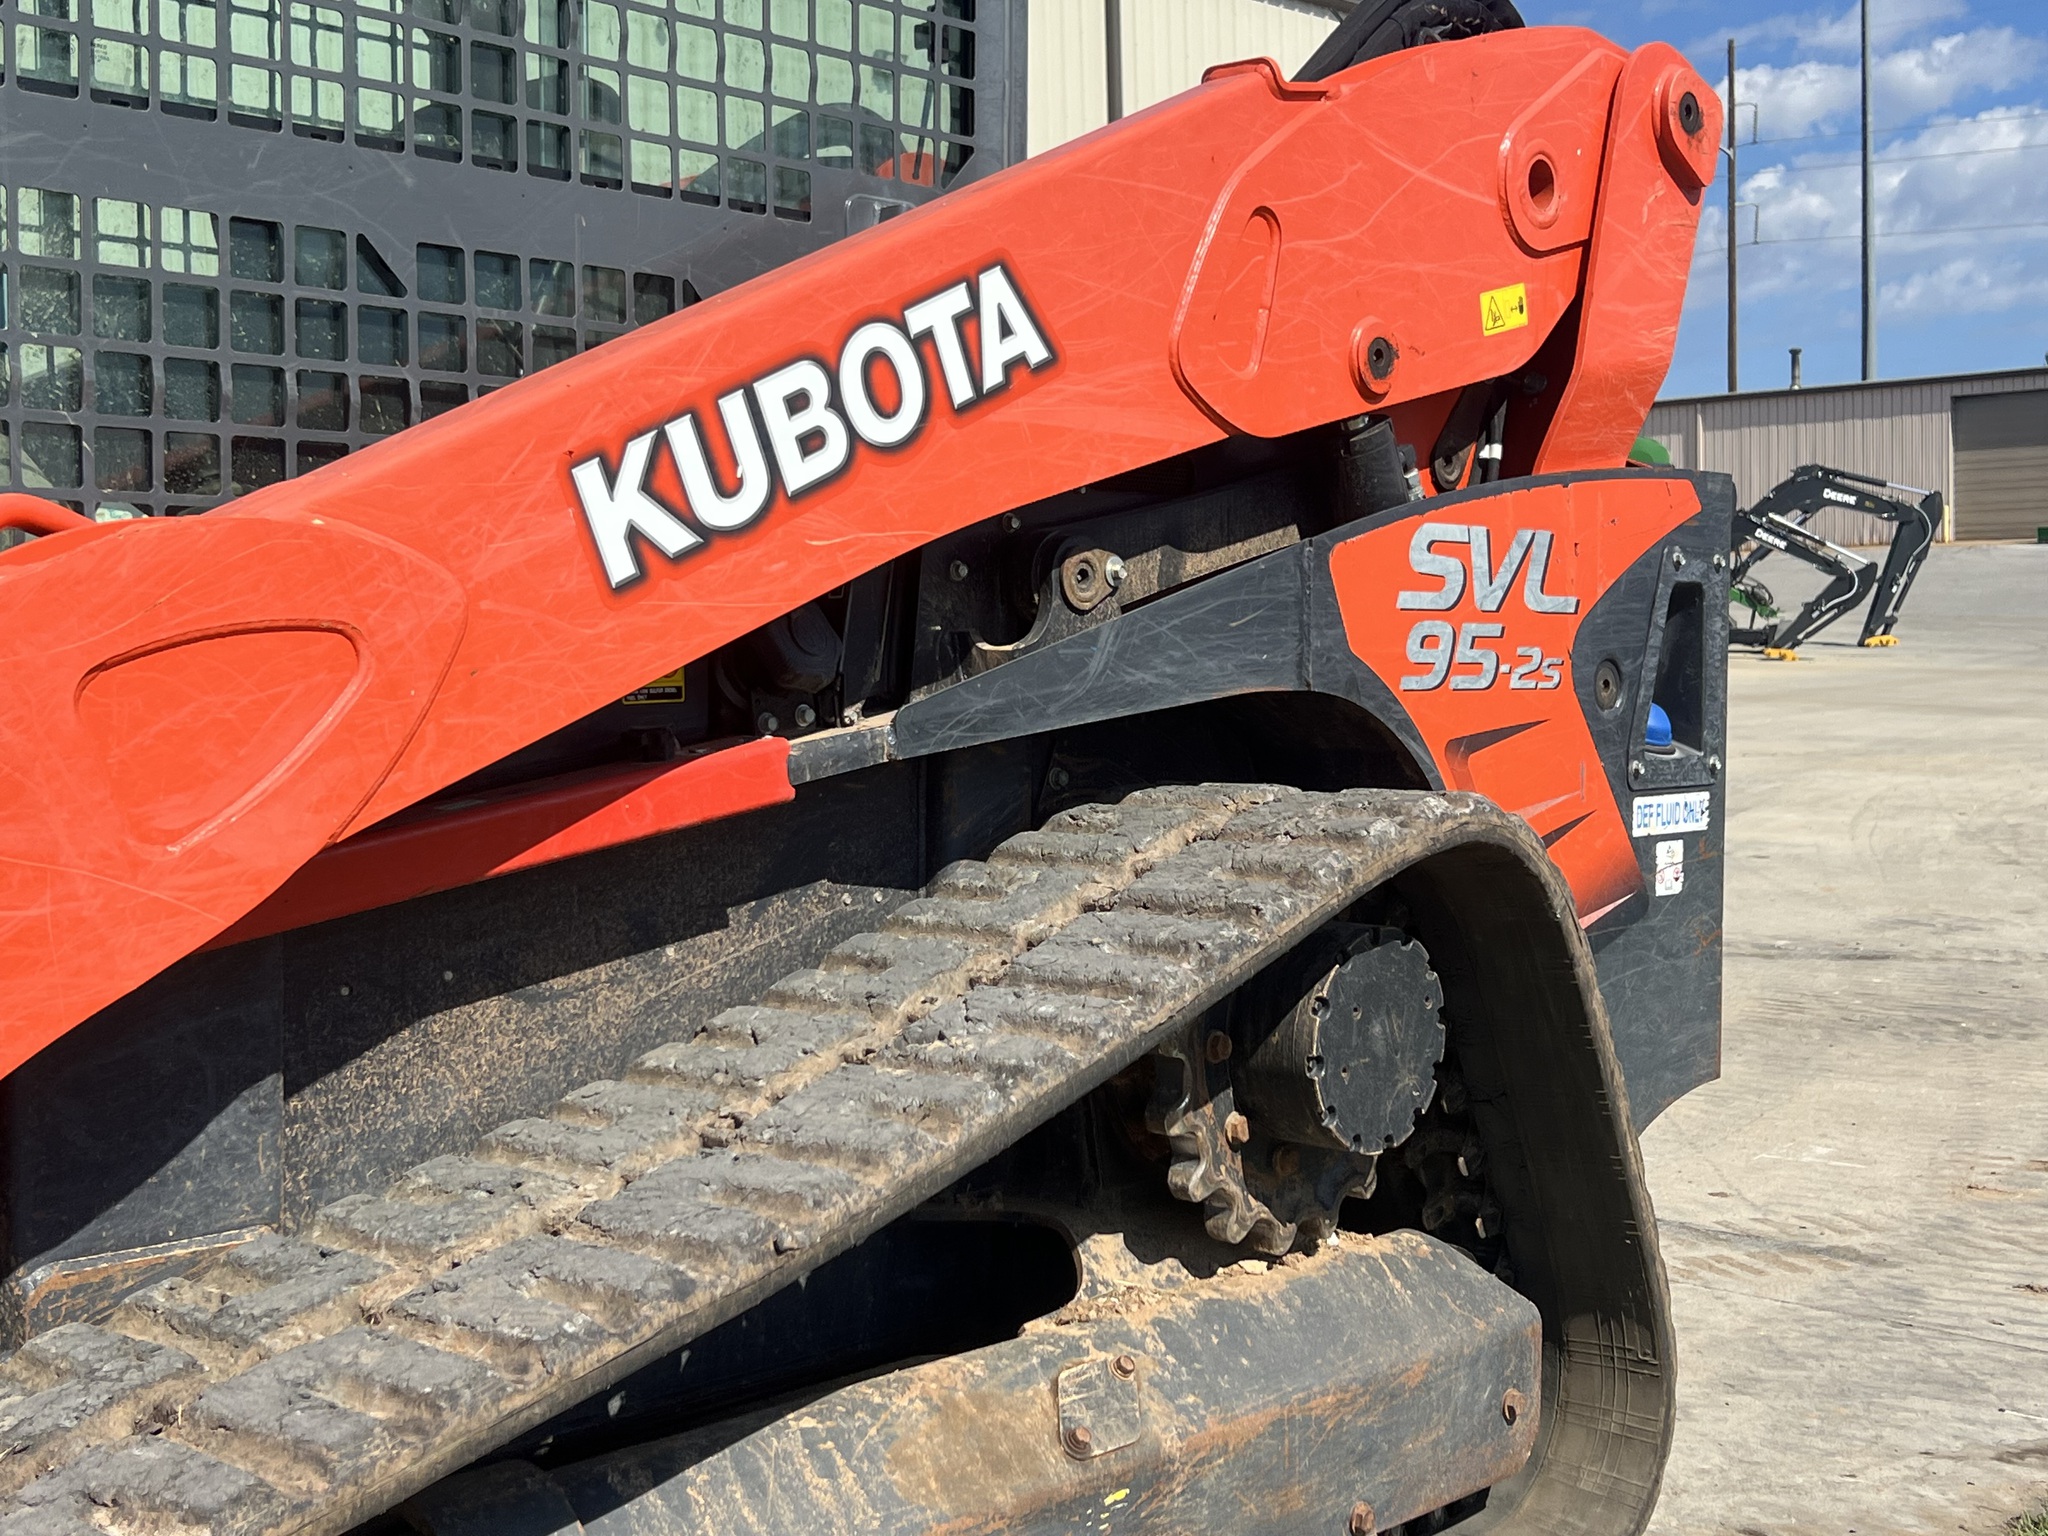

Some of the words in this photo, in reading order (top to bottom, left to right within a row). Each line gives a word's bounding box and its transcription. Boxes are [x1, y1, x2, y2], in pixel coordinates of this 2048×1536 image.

[571, 265, 1054, 590] KUBOTA
[1822, 487, 1858, 506] DEERE
[1754, 528, 1787, 551] DEERE
[1396, 522, 1580, 614] SVL
[1636, 804, 1654, 829] DEF
[1656, 802, 1681, 827] FLUID
